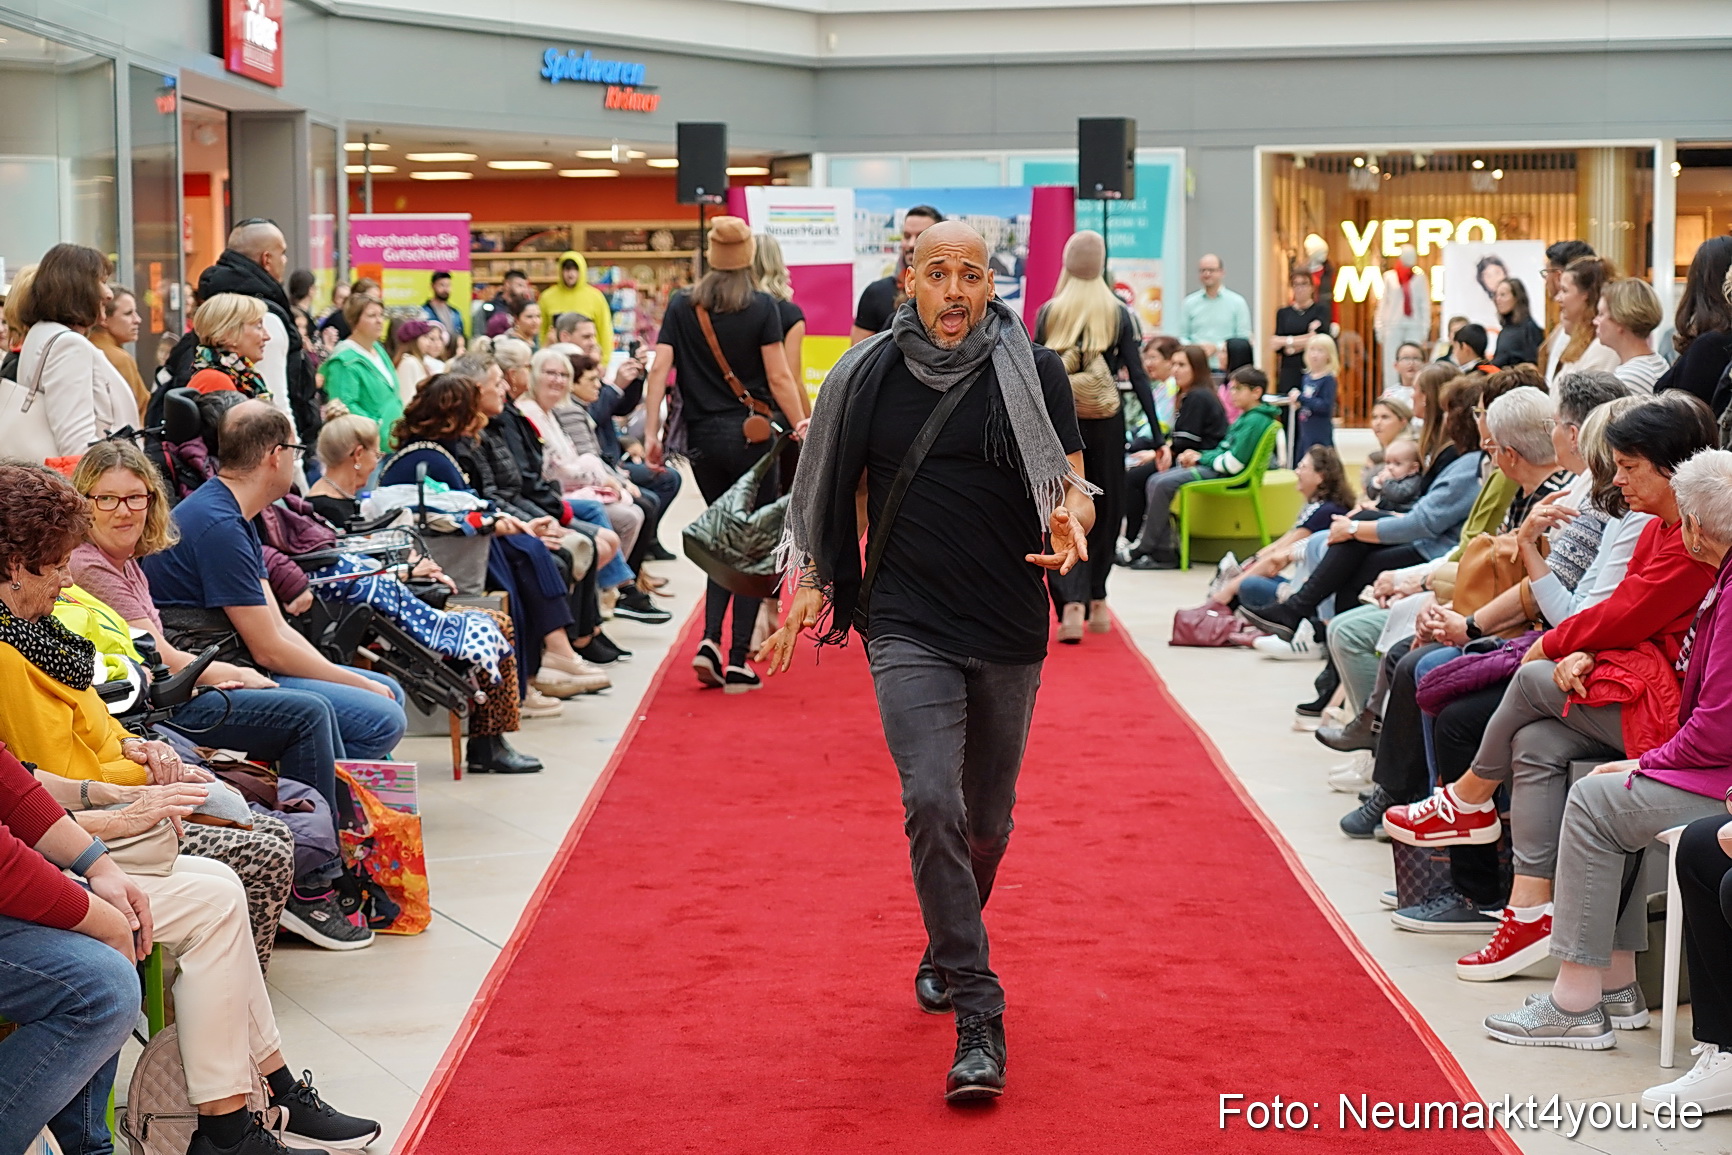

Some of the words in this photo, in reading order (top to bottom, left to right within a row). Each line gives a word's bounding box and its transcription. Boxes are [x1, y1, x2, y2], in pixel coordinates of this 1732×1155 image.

[541, 48, 646, 85] Spielwaren
[356, 233, 436, 248] Verschenken
[437, 233, 459, 247] Sie
[1341, 217, 1497, 257] VERO
[382, 247, 460, 262] Gutscheine!
